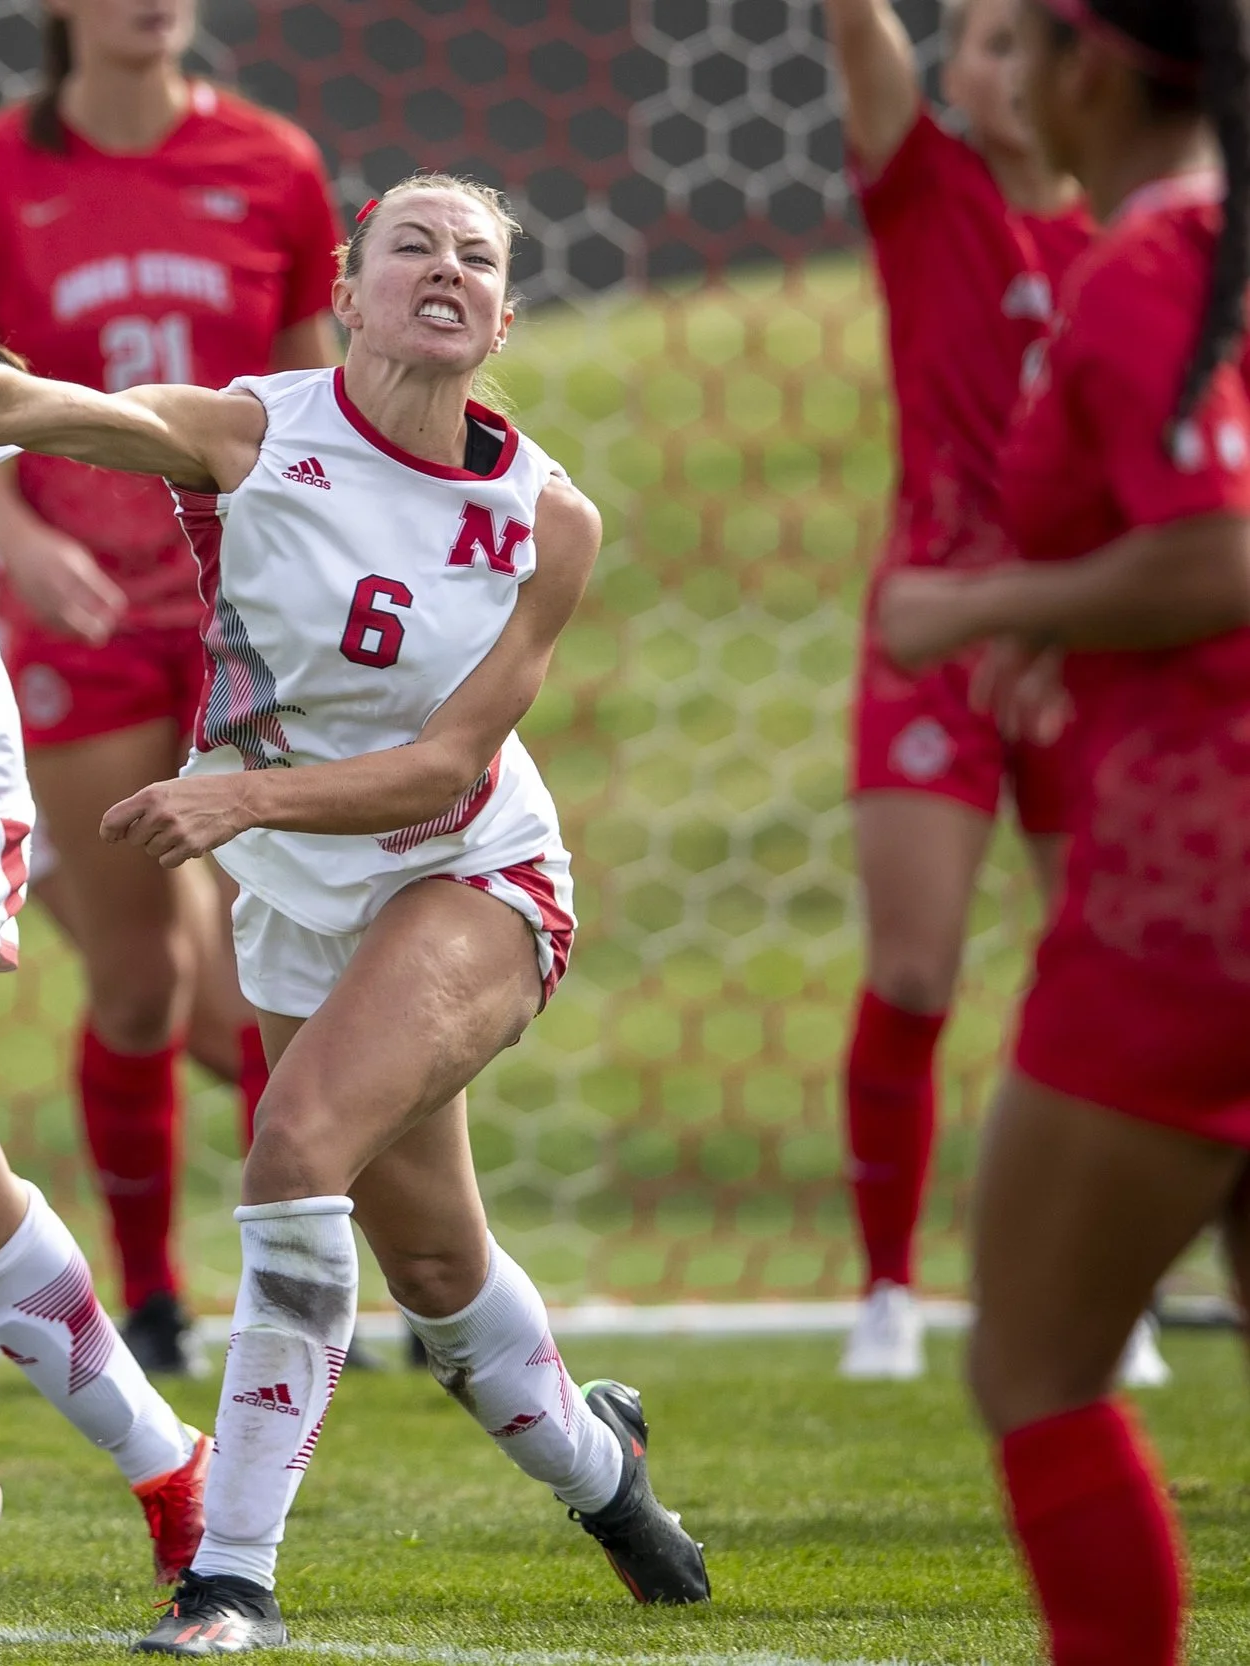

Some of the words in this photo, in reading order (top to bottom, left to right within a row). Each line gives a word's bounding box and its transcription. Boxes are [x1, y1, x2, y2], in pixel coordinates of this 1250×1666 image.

[102, 313, 193, 393] 21
[281, 470, 331, 491] adidas
[445, 500, 532, 577] N
[339, 574, 414, 669] 6
[232, 1394, 300, 1416] adidas
